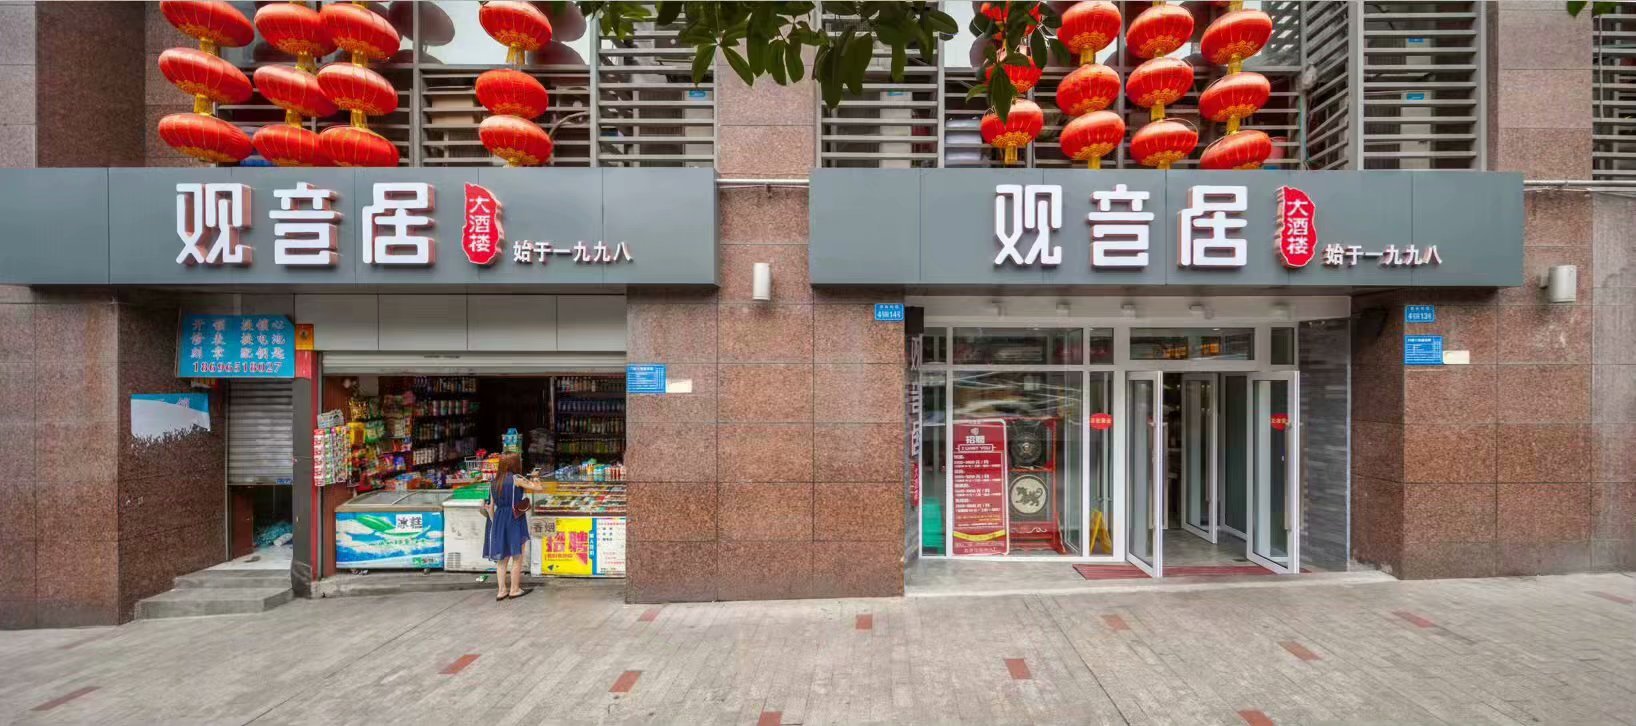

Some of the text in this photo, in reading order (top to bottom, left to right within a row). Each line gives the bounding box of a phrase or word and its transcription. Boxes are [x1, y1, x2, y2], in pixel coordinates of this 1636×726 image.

[176, 182, 432, 265] 观音居
[468, 196, 491, 253] 大酒楼
[993, 184, 1248, 267] 观音居
[1286, 198, 1308, 255] 大酒楼
[513, 240, 633, 263] 始于一九九八
[1323, 244, 1443, 266] 始于一九九八
[240, 332, 286, 345] 换电池
[240, 346, 286, 360] 配钥匙
[546, 531, 588, 560] 招聘
